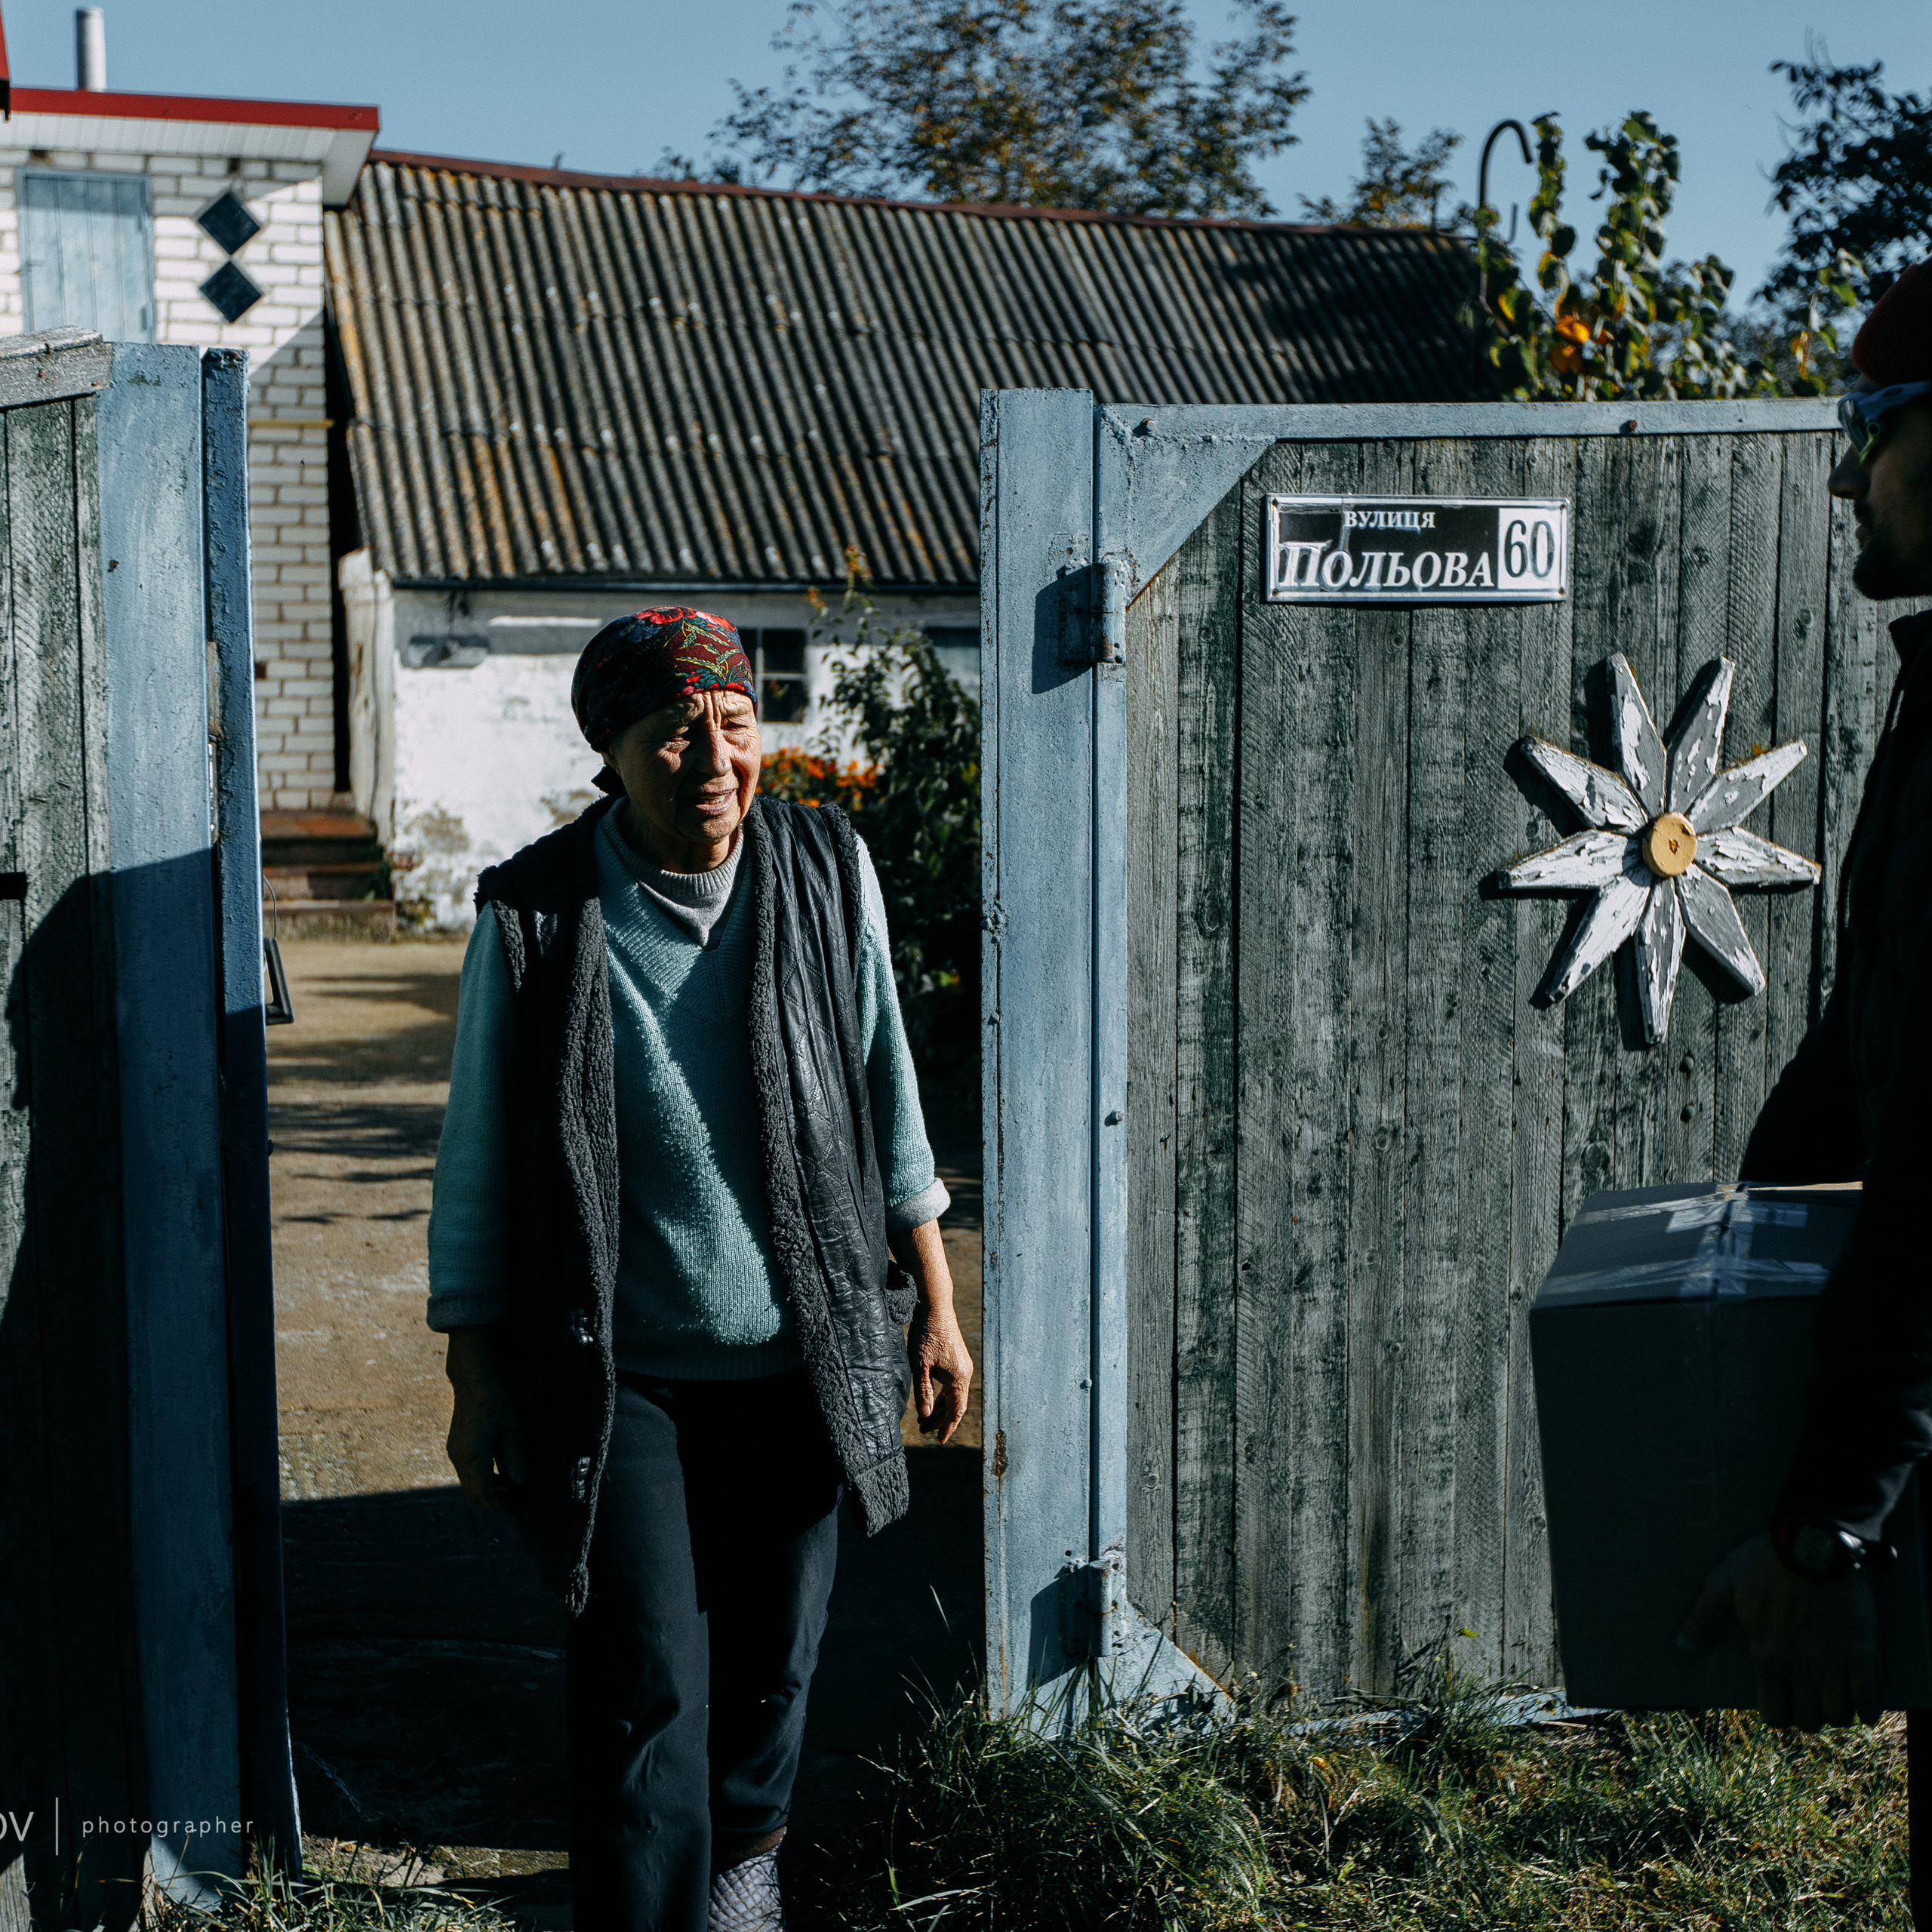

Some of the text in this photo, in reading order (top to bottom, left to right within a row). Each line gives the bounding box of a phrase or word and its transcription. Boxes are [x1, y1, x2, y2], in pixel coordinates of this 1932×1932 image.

[1343, 510, 1436, 534] ВУЛИЦЯ
[1278, 543, 1494, 590] ПОЛЬОВА
[1504, 519, 1555, 578] 60
